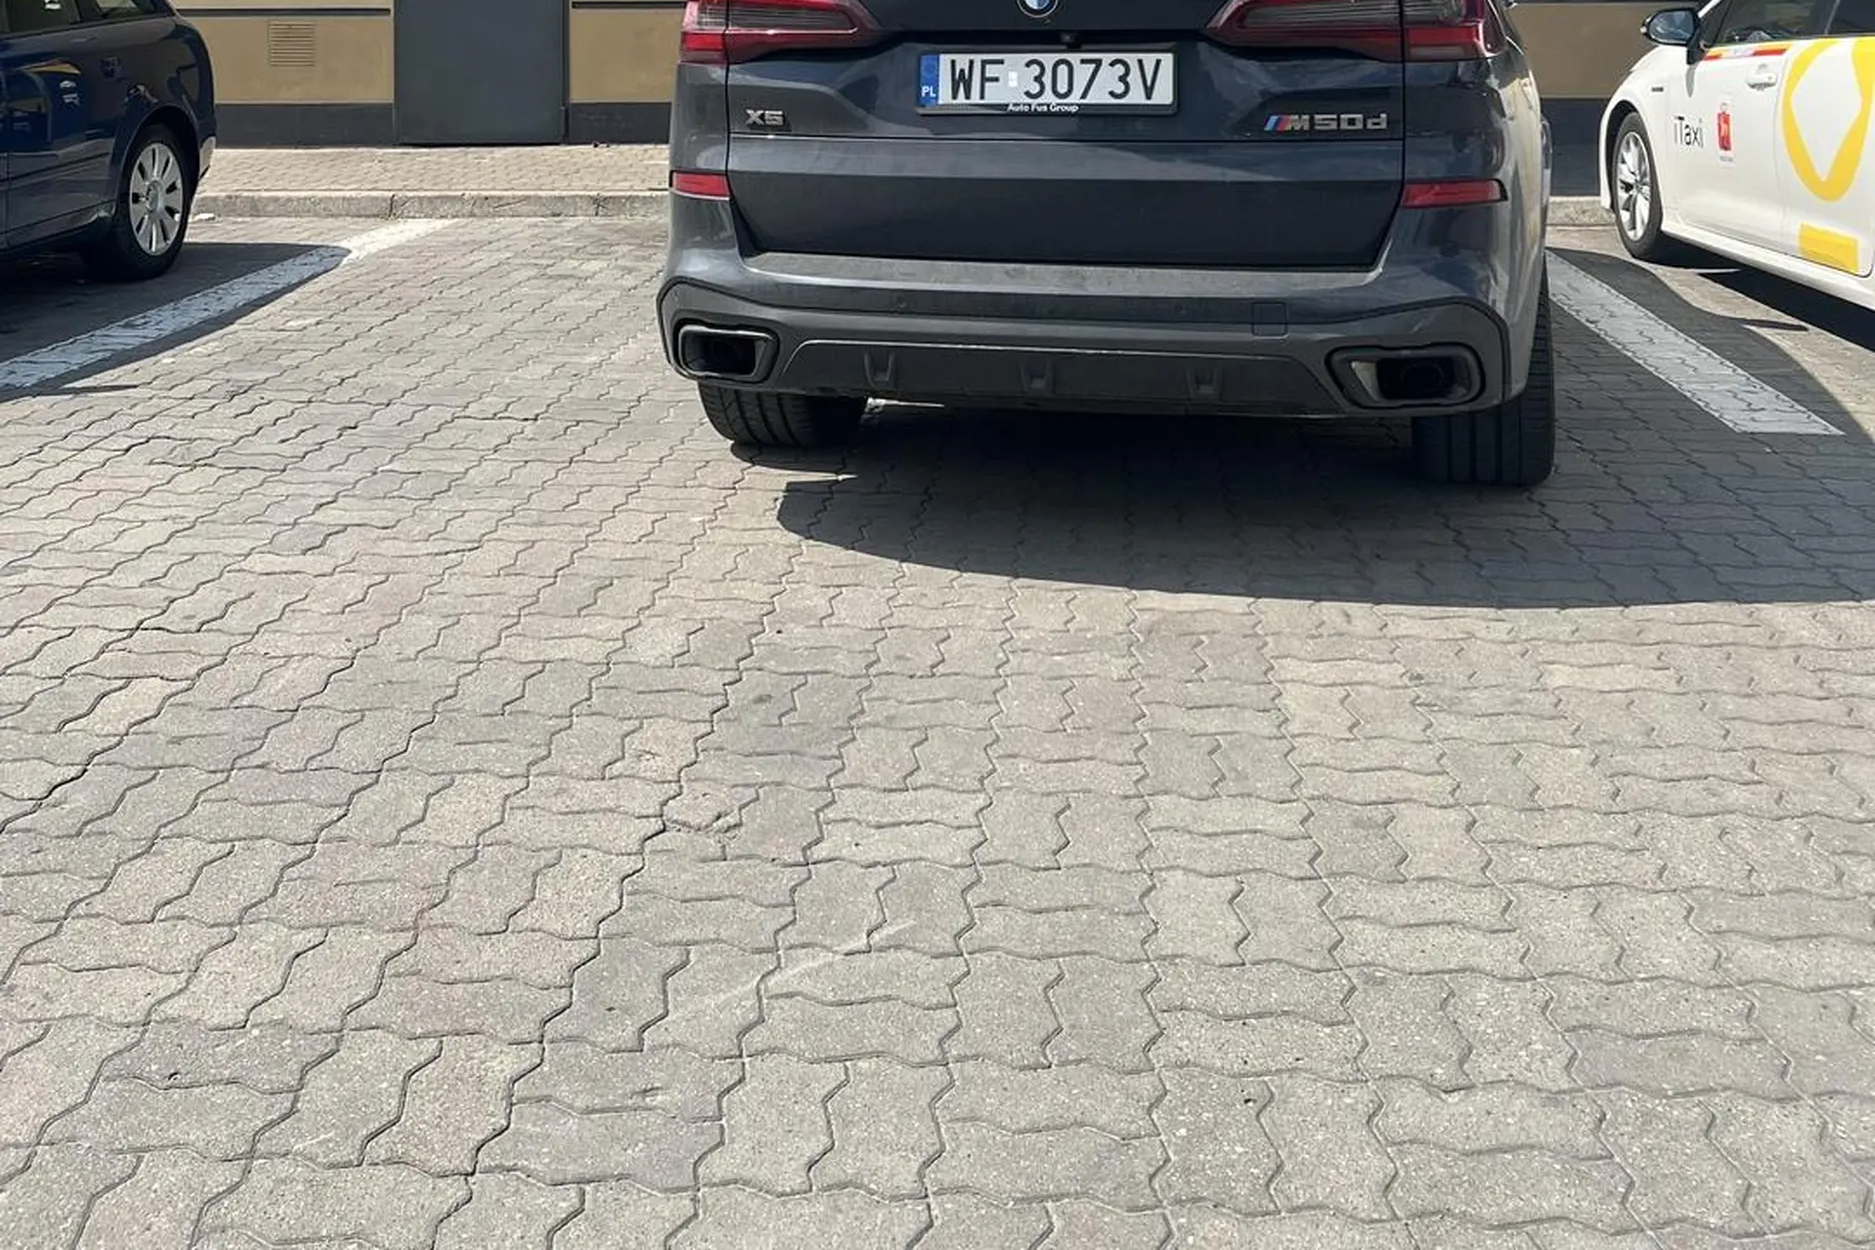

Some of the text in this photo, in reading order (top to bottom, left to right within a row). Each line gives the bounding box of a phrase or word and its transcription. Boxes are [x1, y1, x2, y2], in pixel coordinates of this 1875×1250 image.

[951, 58, 1162, 100] WF 3073V
[921, 87, 936, 98] PL
[1007, 103, 1030, 112] Auto
[1049, 103, 1079, 114] Group
[745, 109, 783, 125] X5
[1286, 114, 1387, 130] M50d
